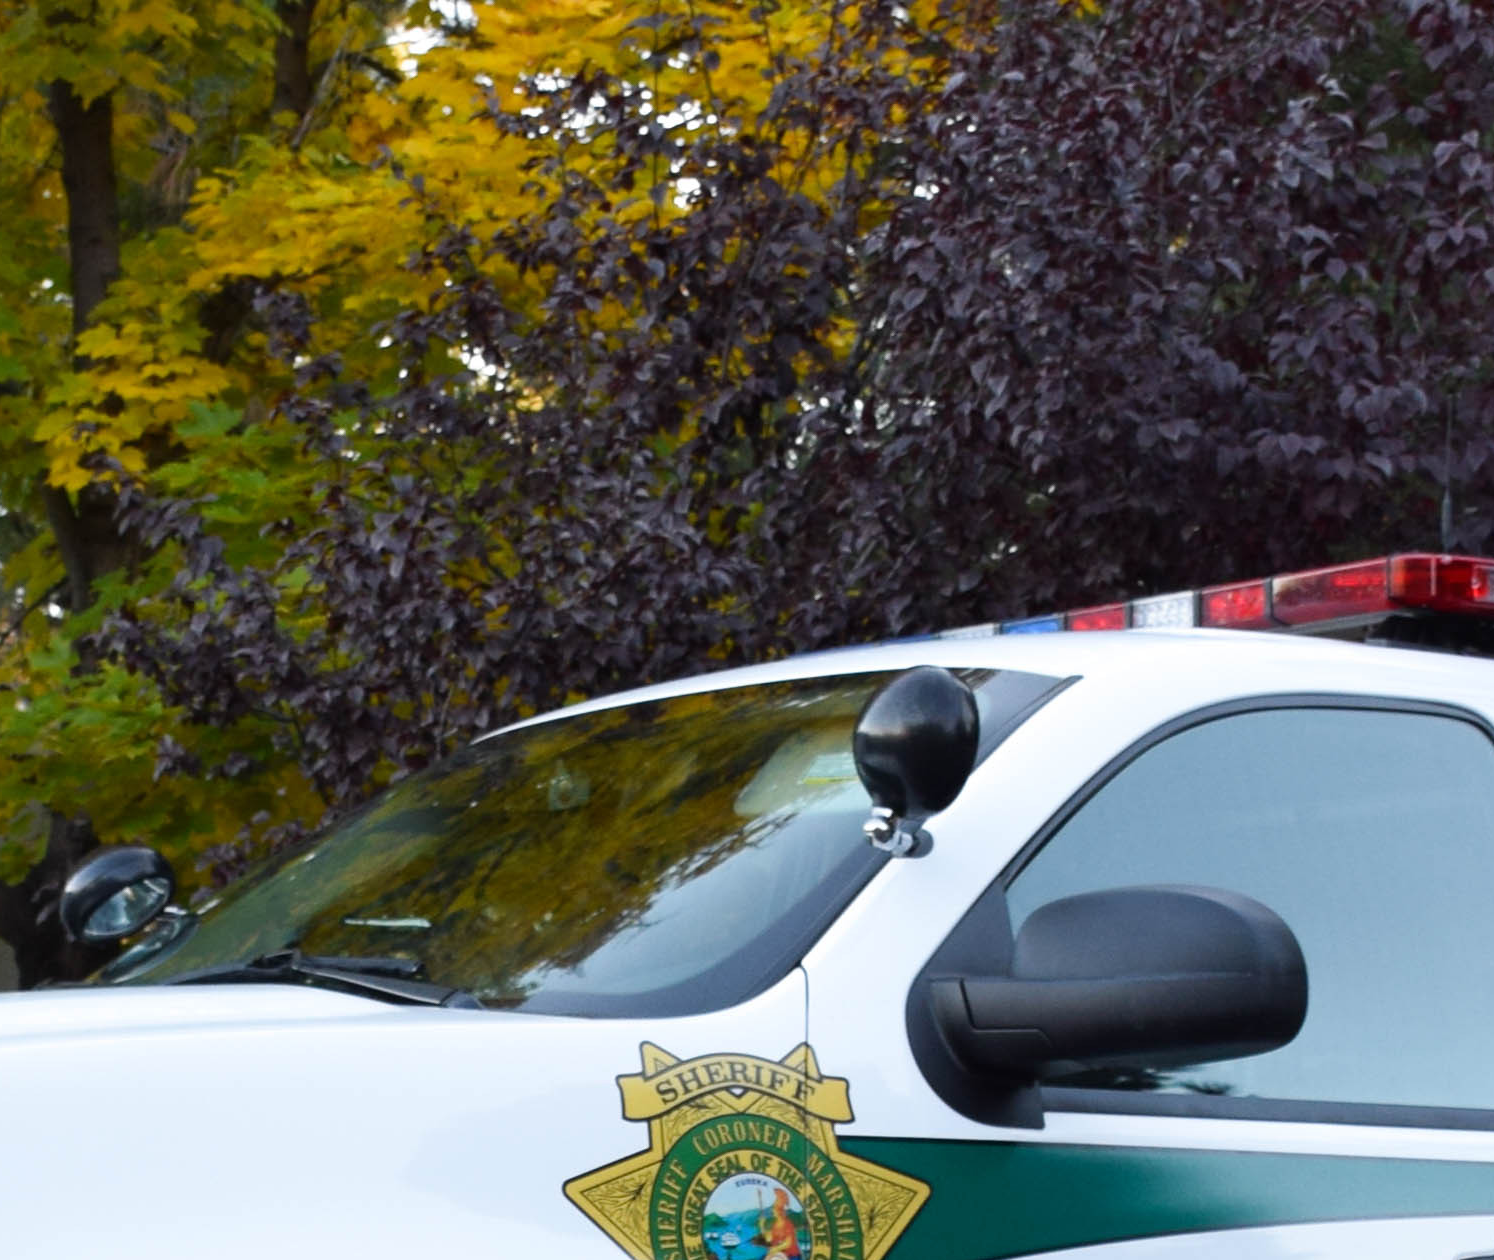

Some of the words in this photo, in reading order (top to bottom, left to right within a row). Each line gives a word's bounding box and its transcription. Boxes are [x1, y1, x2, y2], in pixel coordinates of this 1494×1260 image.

[656, 1060, 815, 1105] SHERIFF
[692, 1120, 791, 1155] CORONER
[684, 1177, 712, 1237] GREAT
[707, 1153, 746, 1182] SEAL
[750, 1153, 772, 1173] OF
[777, 1161, 804, 1194] THE
[807, 1193, 827, 1246] STATE
